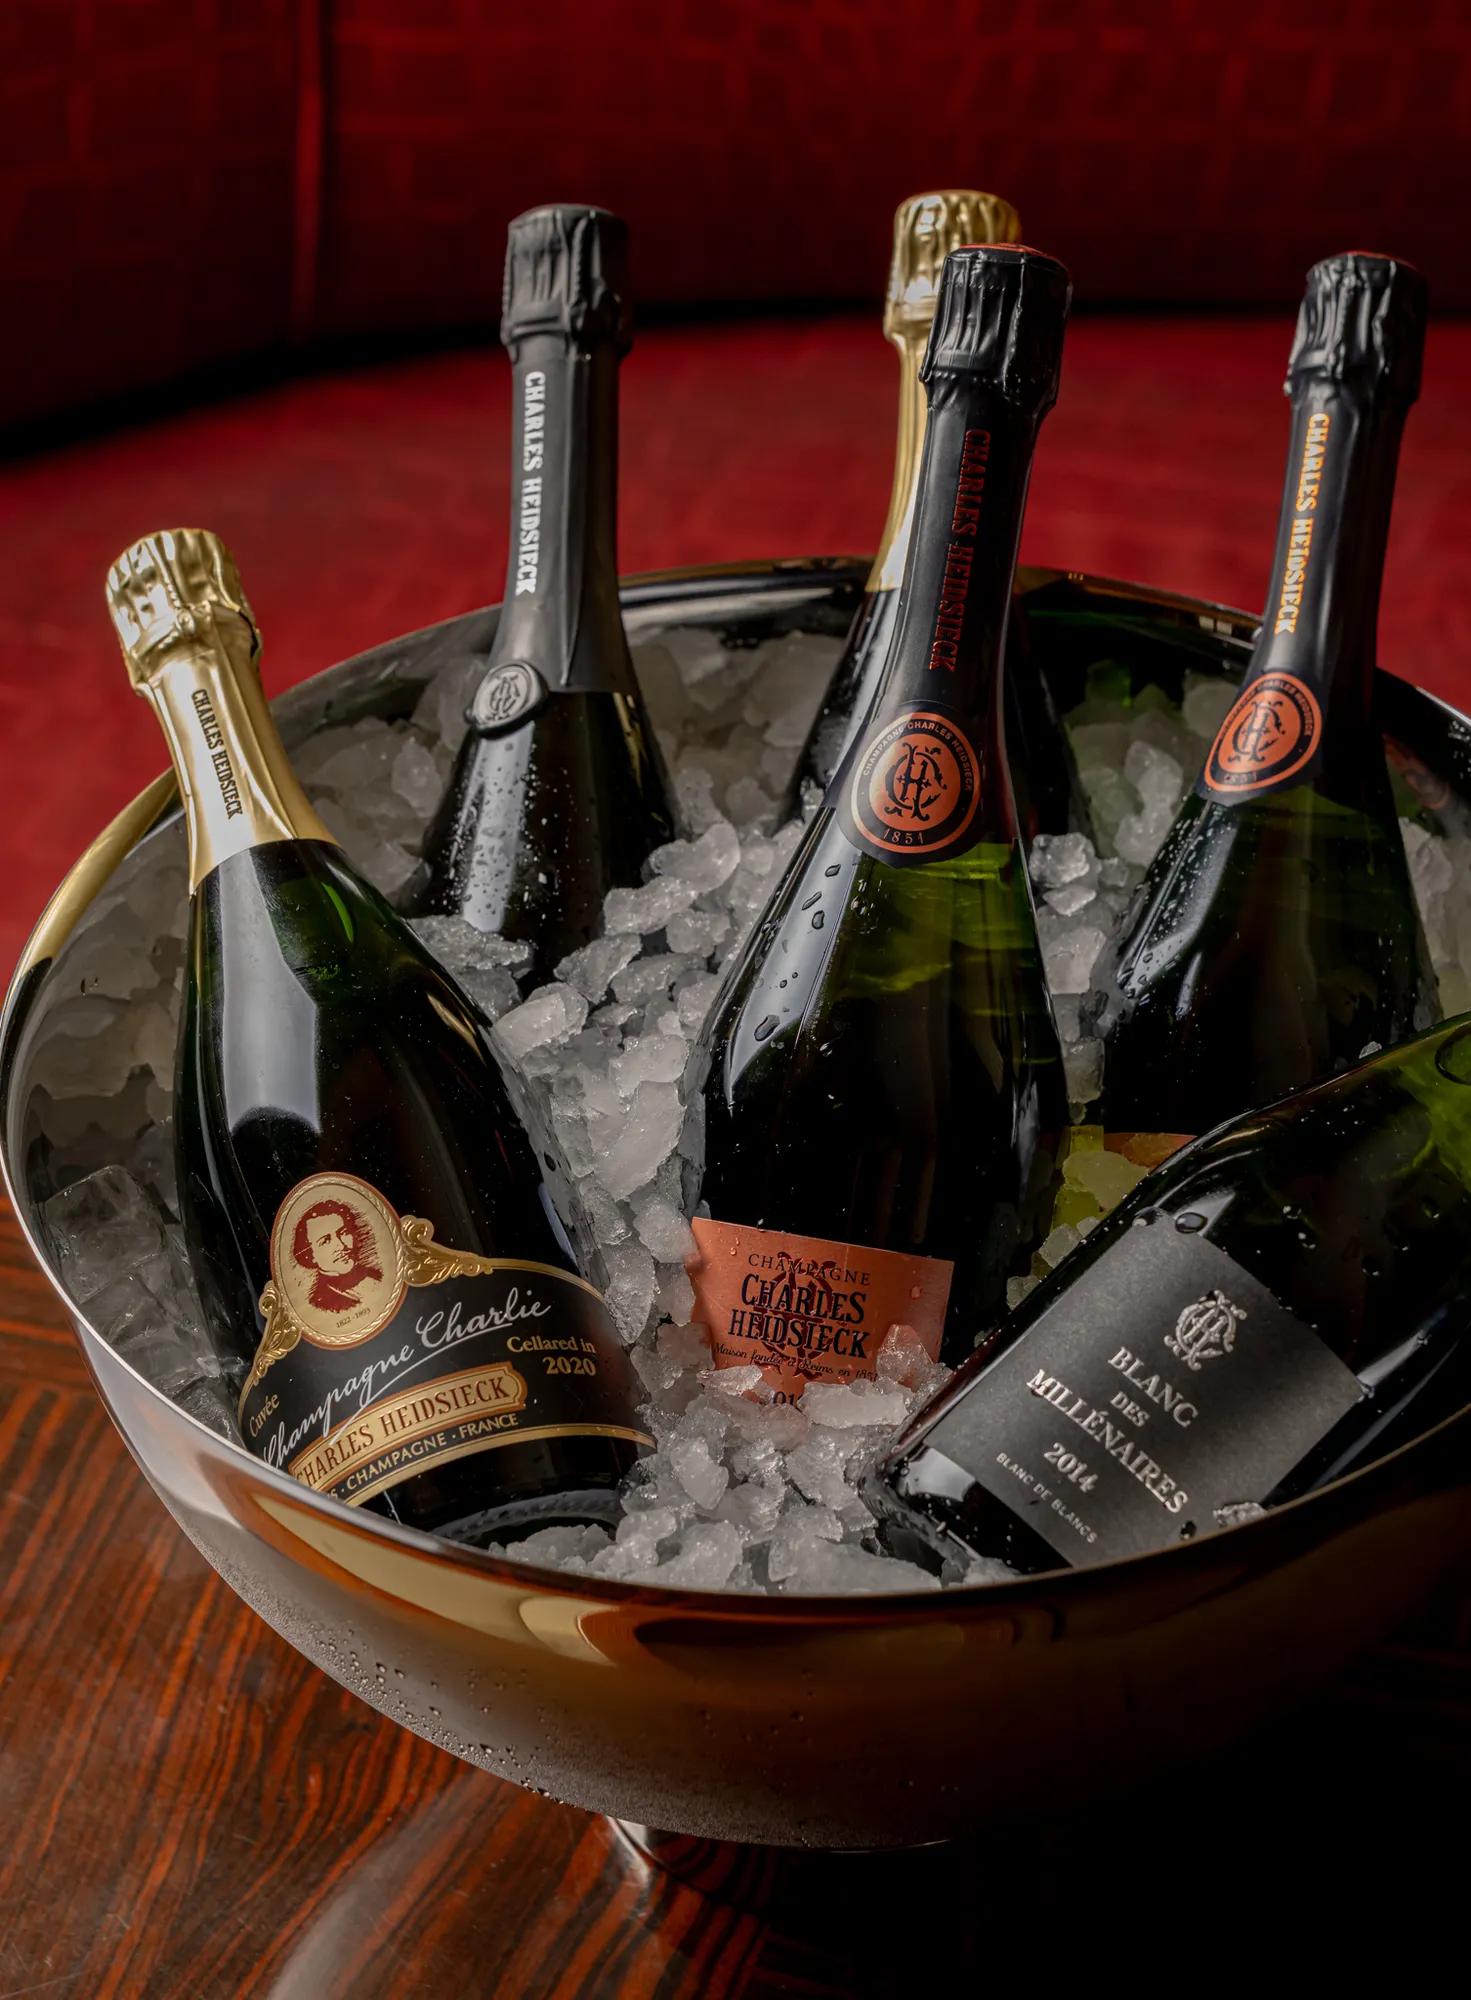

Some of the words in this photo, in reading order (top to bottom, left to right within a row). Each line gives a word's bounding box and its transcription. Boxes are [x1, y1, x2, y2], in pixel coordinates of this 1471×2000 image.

[523, 371, 545, 472] CHARLES
[952, 428, 990, 538] CHARLES
[1296, 412, 1330, 512] CHARLES
[515, 476, 542, 596] HEIDSIECK
[1274, 517, 1313, 634] HEIDSIECK
[929, 543, 974, 672] HEIDSIECK
[192, 688, 226, 750] CHARLES
[211, 748, 243, 820] HEIDSIECK
[907, 720, 952, 741] CHARLES
[883, 828, 925, 845] 1851
[741, 1273, 867, 1324] CHARLES
[748, 1253, 872, 1286] CHAMPAGNE
[415, 1286, 551, 1348] Charlie
[506, 1335, 579, 1353] Cellared
[580, 1338, 597, 1354] in
[727, 1308, 870, 1359] HEIDSIECK
[542, 1356, 597, 1377] 2020
[714, 1342, 748, 1359] Maison
[249, 1394, 281, 1438] Cuvée
[378, 1375, 511, 1437] HEIDSIECK
[1107, 1346, 1199, 1429] BLANC
[1110, 1391, 1150, 1428] DES
[346, 1431, 446, 1491] CHAMPAGNE
[458, 1412, 519, 1439] FRANCE
[1026, 1368, 1189, 1514] MILLÉNAIRES
[1043, 1442, 1099, 1492] 2014
[996, 1452, 1034, 1485] BLANC
[1033, 1482, 1051, 1501] DE
[1052, 1498, 1098, 1544] BLANCS
